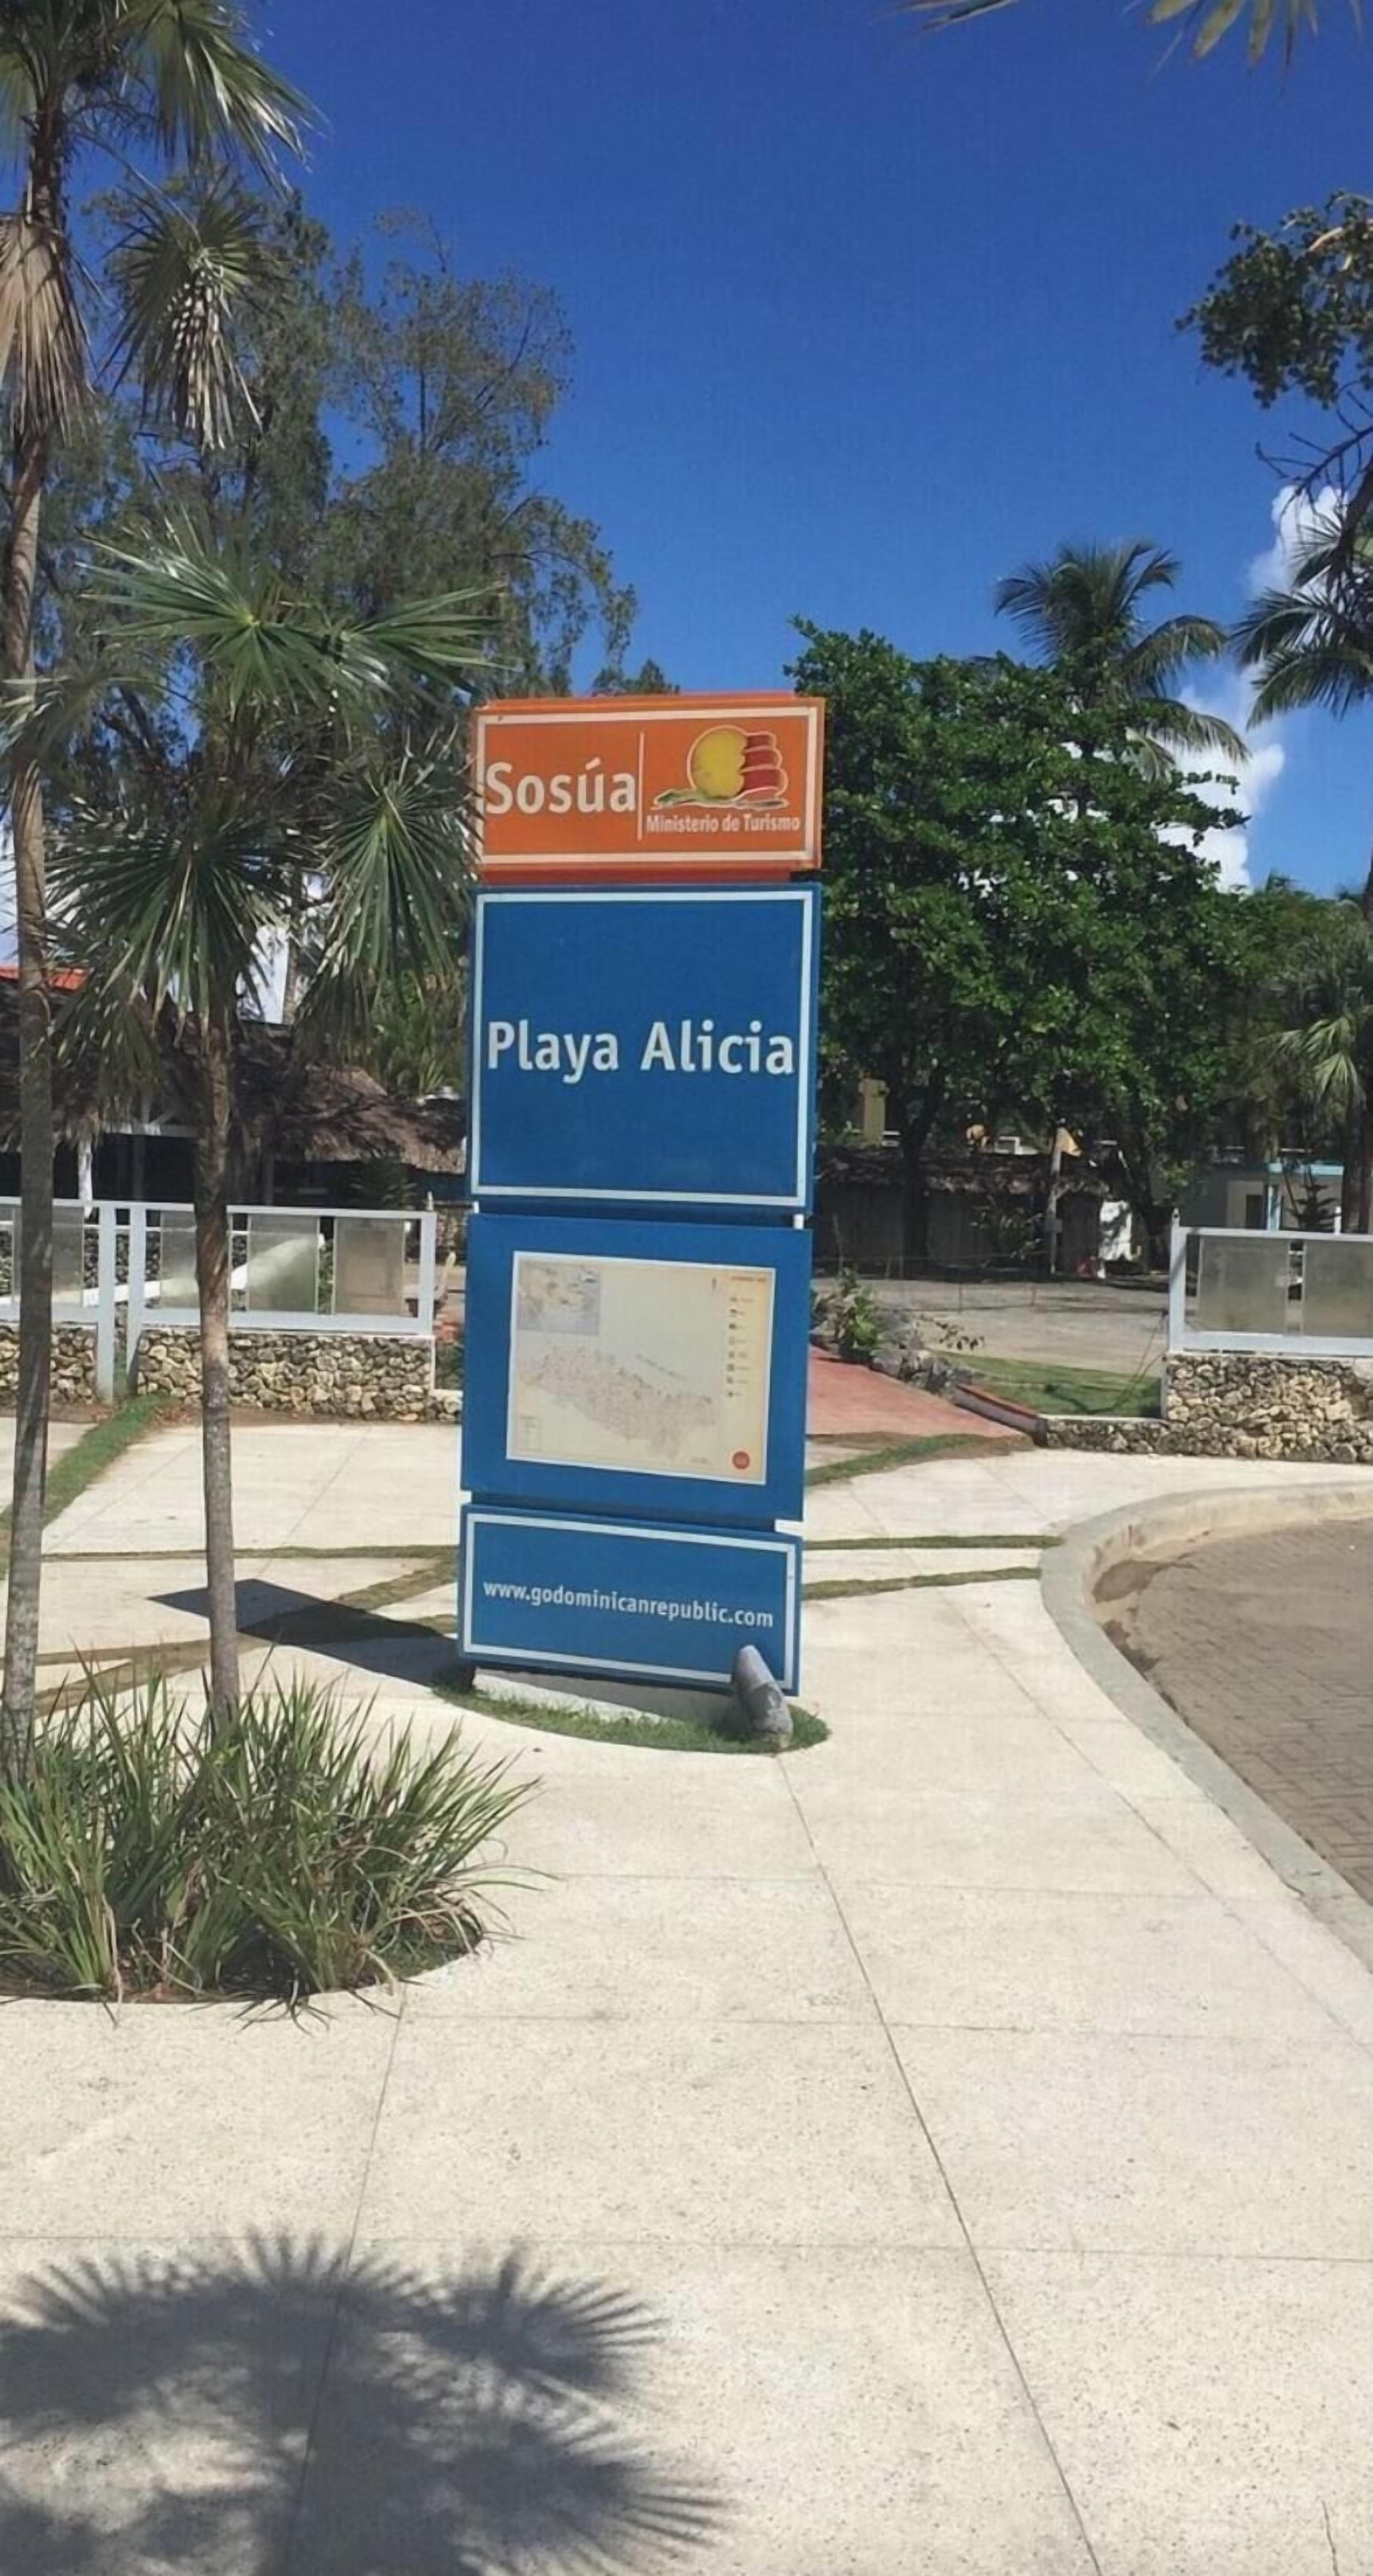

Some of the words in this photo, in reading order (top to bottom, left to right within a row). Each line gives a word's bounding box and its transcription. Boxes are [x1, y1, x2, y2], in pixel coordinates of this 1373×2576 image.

[485, 756, 636, 815] Sosúa
[646, 813, 719, 834] Ministerio
[722, 814, 739, 832] de
[743, 813, 801, 832] Turismo
[487, 1019, 619, 1084] Playa
[640, 1019, 795, 1074] Alicia
[483, 1581, 773, 1627] www.godominicanrepublic.com
